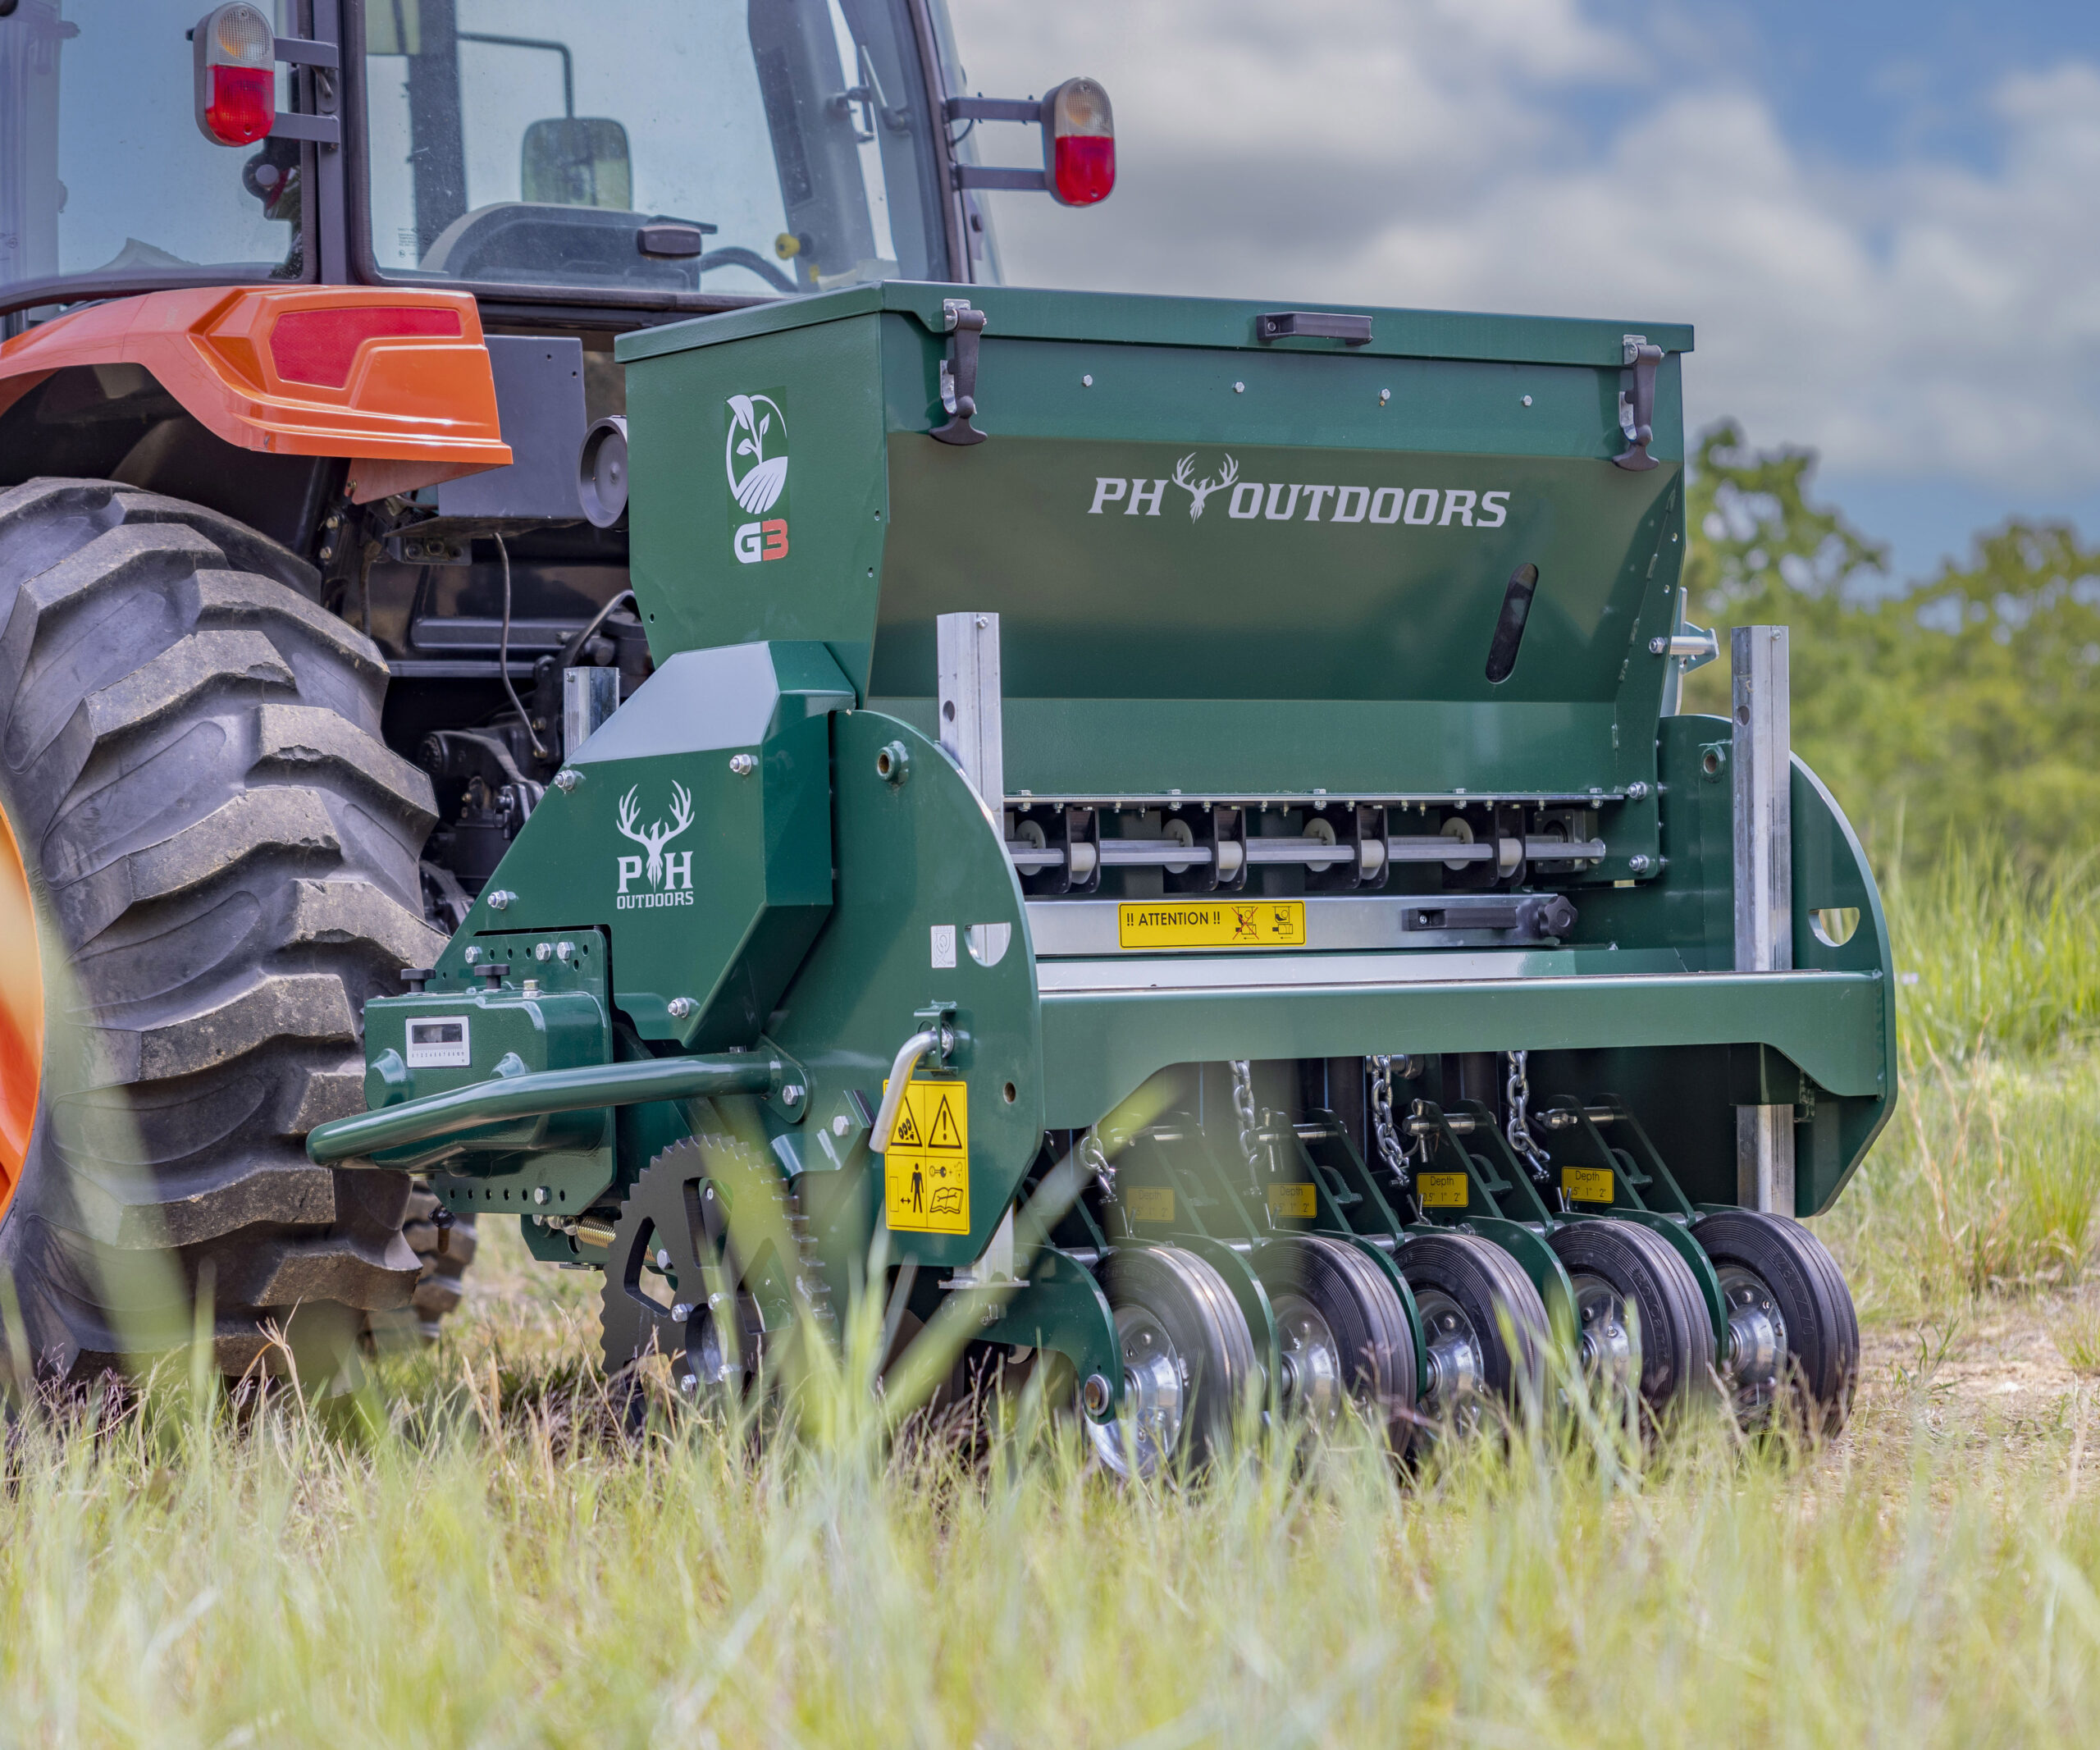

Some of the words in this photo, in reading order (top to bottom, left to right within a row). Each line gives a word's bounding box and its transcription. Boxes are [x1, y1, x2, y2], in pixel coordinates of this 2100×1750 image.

[1087, 477, 1169, 516] PH
[1229, 482, 1511, 528] OUTDOORS
[733, 519, 789, 564] G3
[617, 851, 694, 893] PH
[617, 891, 694, 910] OUTDOORS
[1126, 912, 1134, 926] !!
[1139, 912, 1209, 926] ATTENTION
[1213, 911, 1221, 925] !!
[1430, 1176, 1454, 1188] Depth
[1575, 1170, 1600, 1182] Depth
[1139, 1190, 1162, 1201] Depth
[1280, 1186, 1303, 1197] Depth
